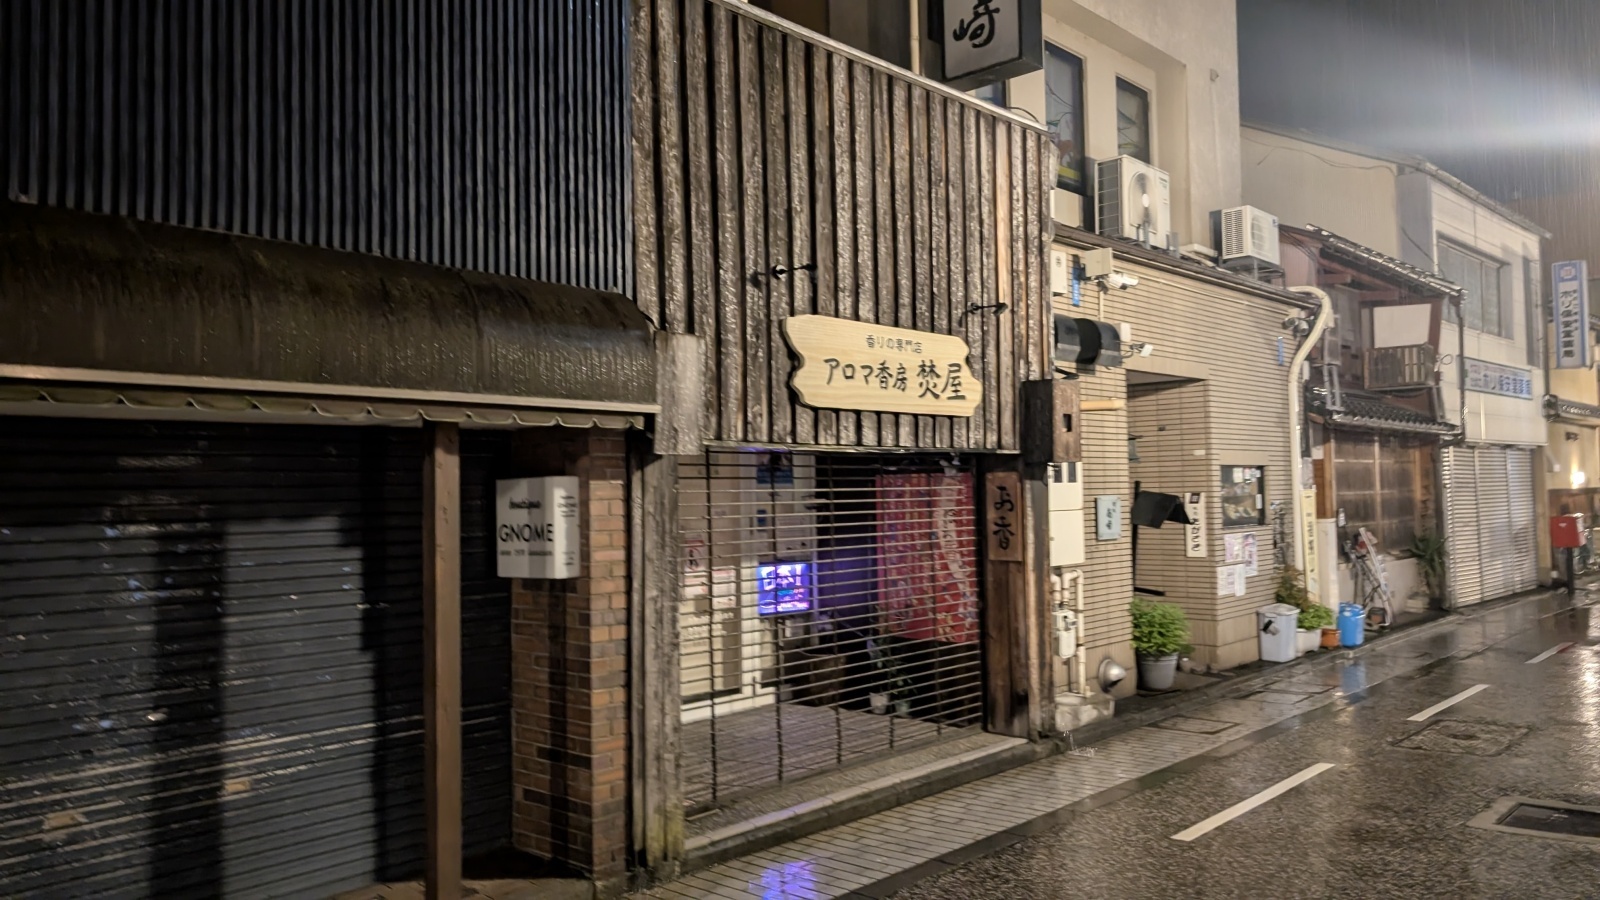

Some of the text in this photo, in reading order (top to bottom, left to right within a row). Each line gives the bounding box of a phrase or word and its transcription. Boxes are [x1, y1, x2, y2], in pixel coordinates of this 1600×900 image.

[866, 335, 922, 353] 香りの専門店
[823, 358, 966, 400] アロマ香房 焚屋
[499, 523, 553, 542] GNOME
